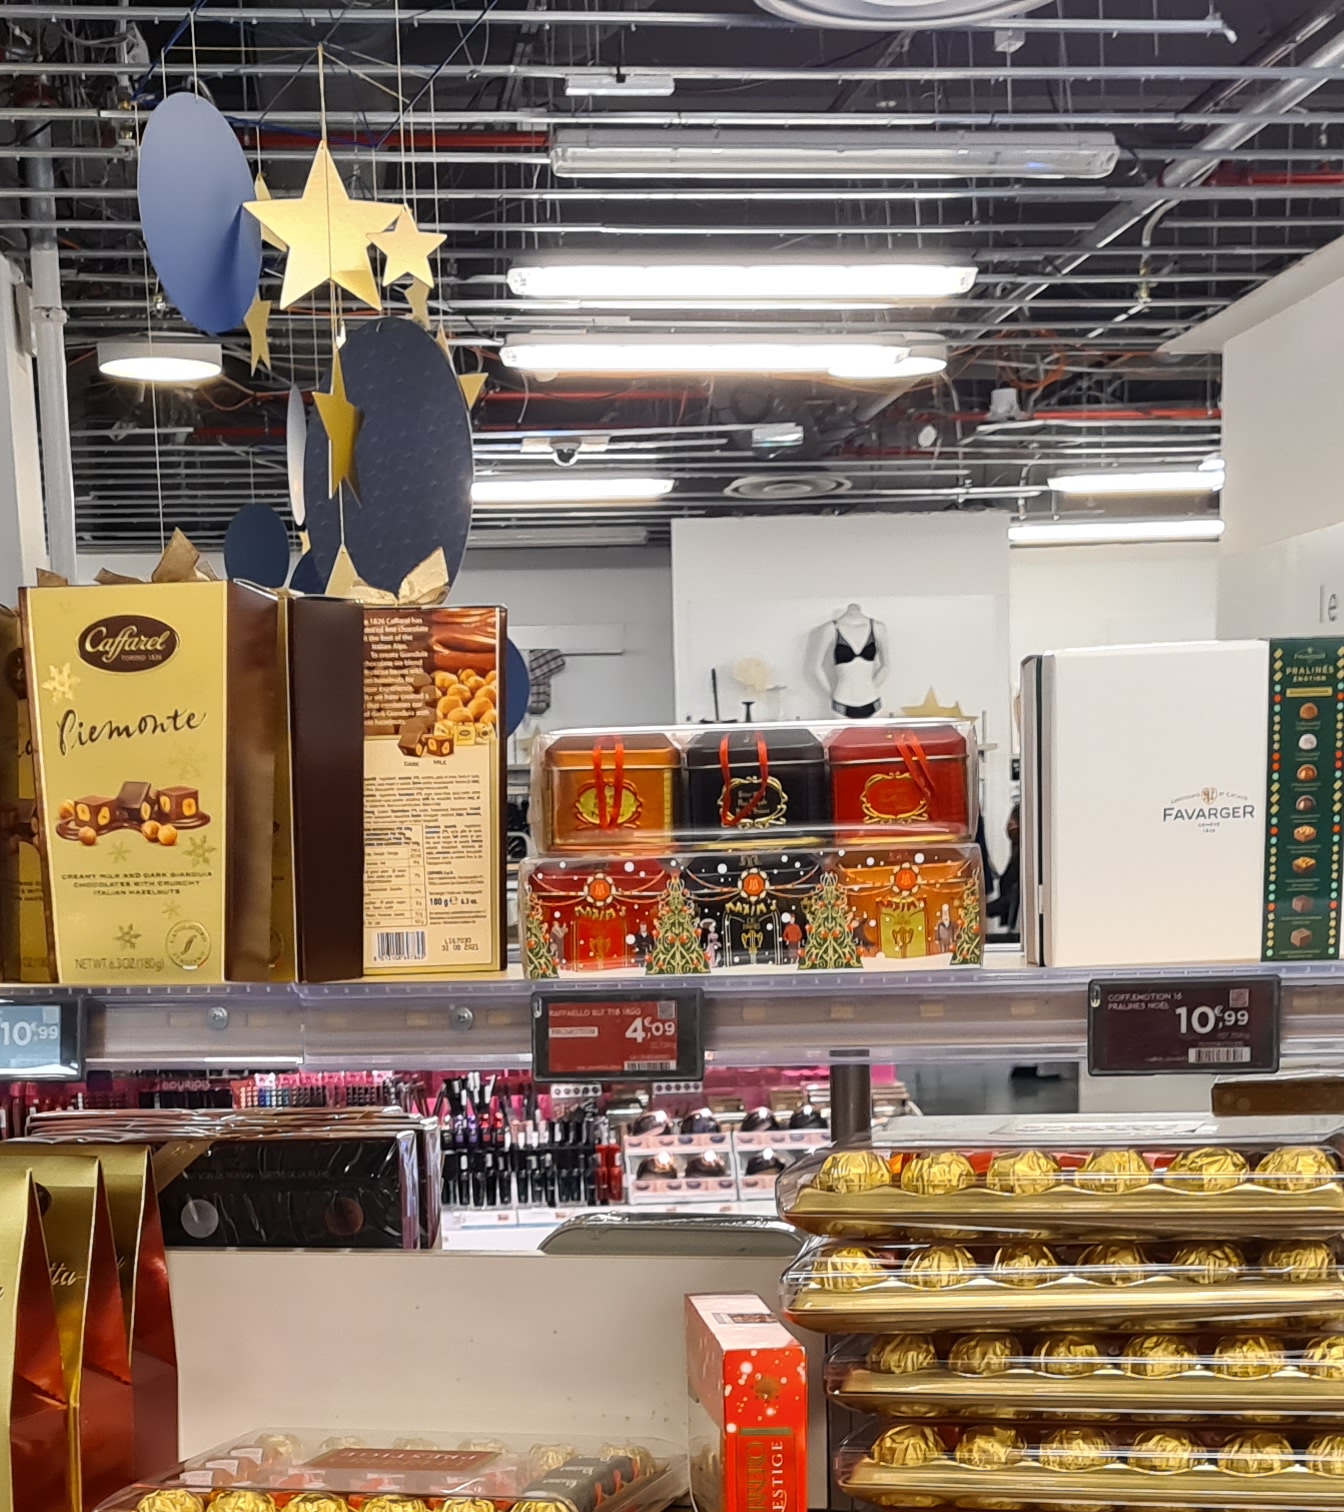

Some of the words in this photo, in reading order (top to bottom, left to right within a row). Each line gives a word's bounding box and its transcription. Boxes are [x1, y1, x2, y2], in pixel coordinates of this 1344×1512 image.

[1319, 583, 1337, 623] le
[85, 626, 166, 665] Caffarel
[58, 708, 206, 756] Piemonte
[1163, 805, 1255, 822] FAVARGER
